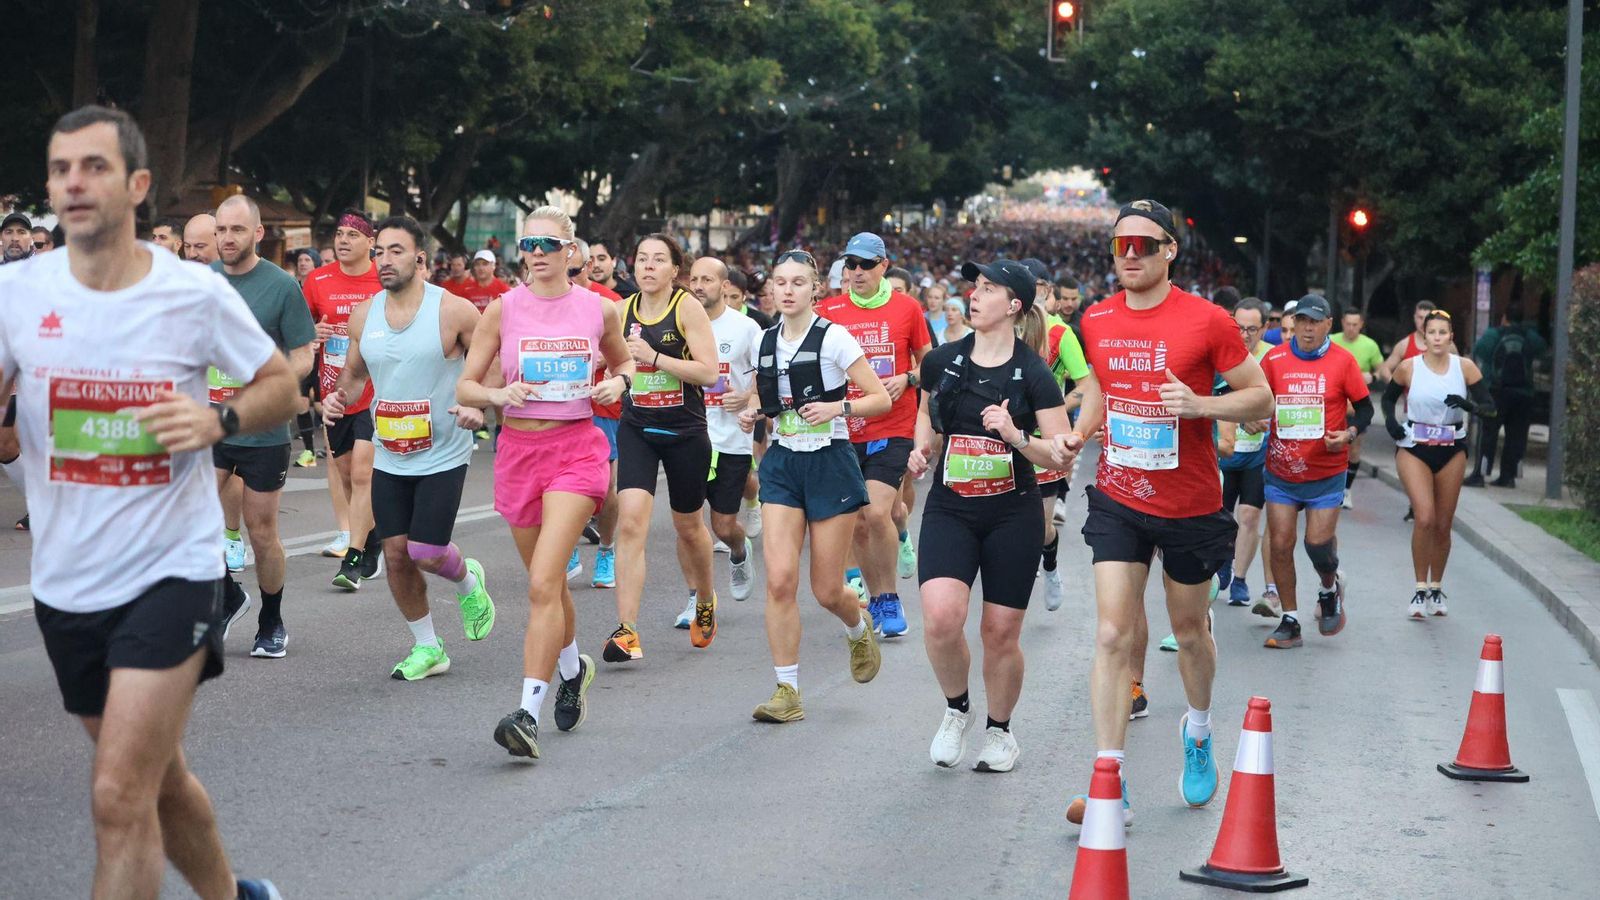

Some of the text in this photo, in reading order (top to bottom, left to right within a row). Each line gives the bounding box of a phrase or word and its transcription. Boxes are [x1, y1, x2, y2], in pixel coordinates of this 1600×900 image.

[850, 321, 878, 330] GENERALI
[540, 340, 586, 350] GENERALI
[1110, 339, 1152, 349] GENERALI
[536, 361, 577, 373] 15196
[1108, 356, 1152, 371] MÁLAGA
[643, 375, 667, 384] 7225
[1288, 383, 1316, 394] MÁLAGA
[386, 403, 425, 412] GENERALI
[1124, 403, 1169, 416] GENERAL
[1286, 410, 1312, 420] 13941
[81, 416, 140, 440] 4388
[388, 420, 415, 431] 1566
[1120, 424, 1161, 440] 12387
[962, 458, 994, 471] 1728
